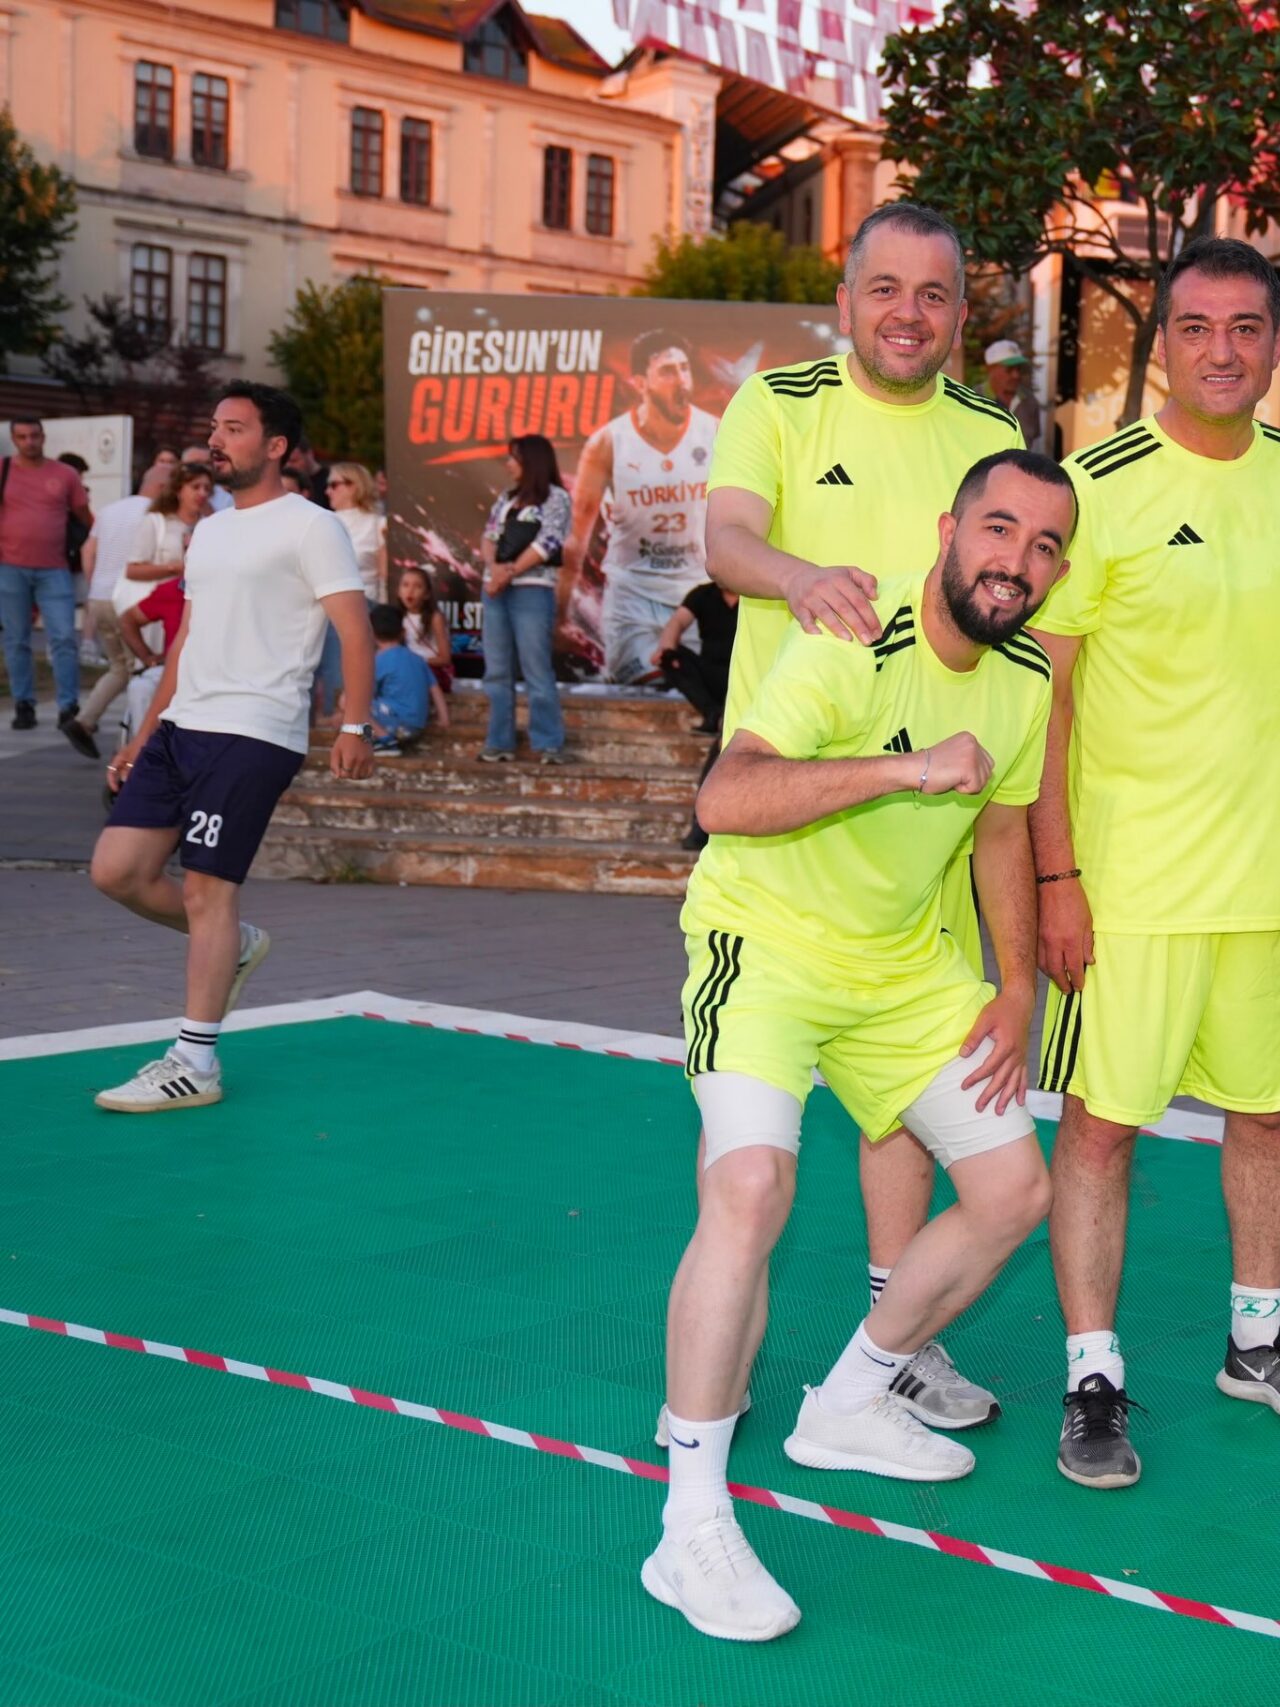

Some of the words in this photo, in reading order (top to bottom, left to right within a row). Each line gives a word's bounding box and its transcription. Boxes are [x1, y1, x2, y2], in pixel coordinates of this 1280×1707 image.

[408, 326, 603, 375] GİRESUN'UN
[408, 374, 615, 444] GURURU
[652, 512, 686, 534] 23
[186, 810, 223, 848] 28
